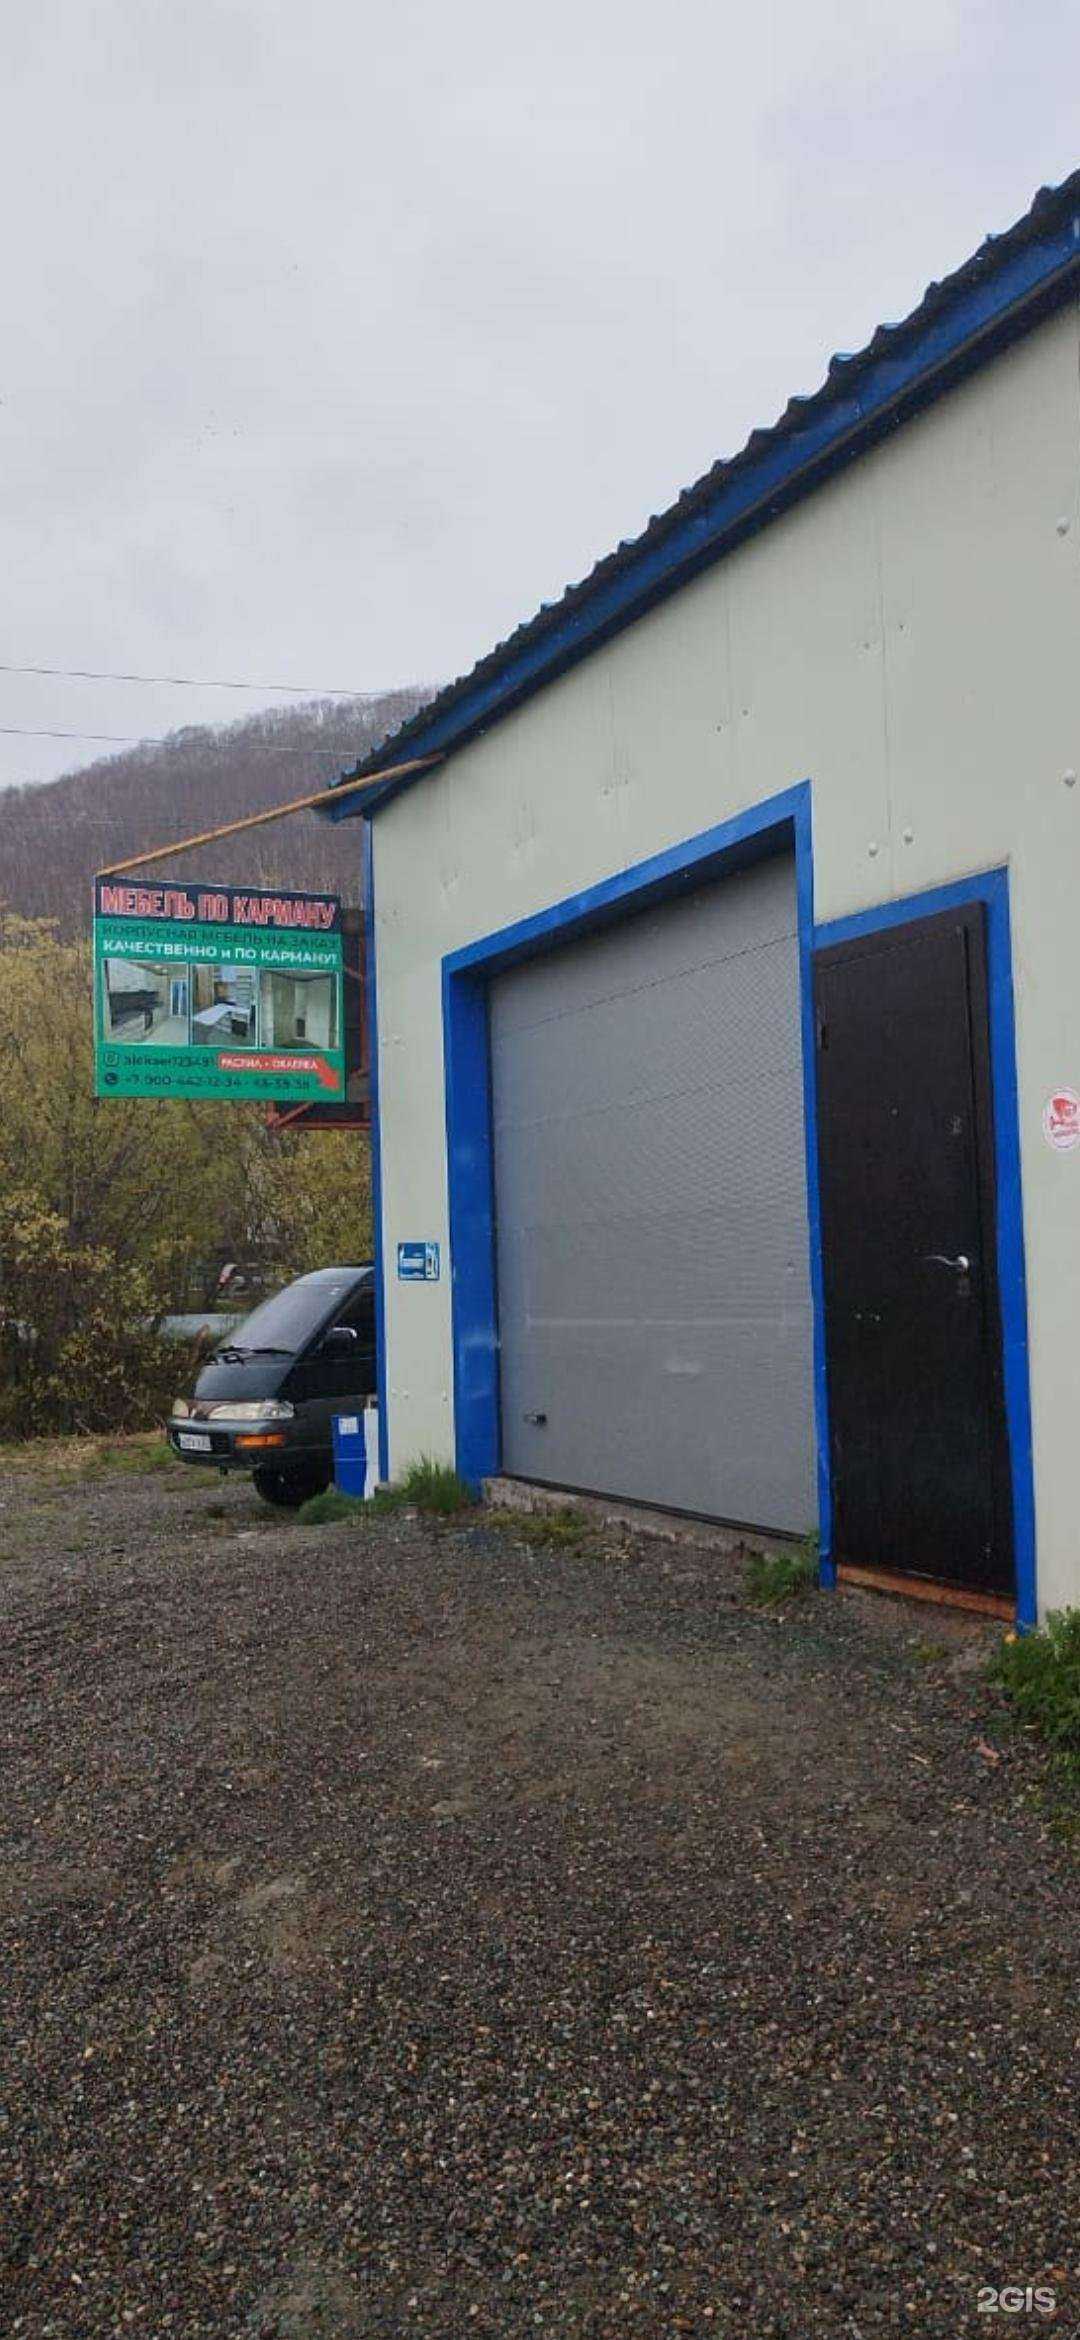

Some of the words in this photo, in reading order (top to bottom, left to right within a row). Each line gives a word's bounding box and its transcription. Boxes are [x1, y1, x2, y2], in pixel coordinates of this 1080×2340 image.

[101, 886, 195, 919] МЕБЕЛЬ
[198, 894, 229, 922] ПО
[233, 896, 335, 929] КАРМАНУ
[202, 930, 261, 945] МЕБЕЛЬ
[103, 940, 217, 957] КАЧЕСТВЕННО
[235, 947, 256, 959] ПО
